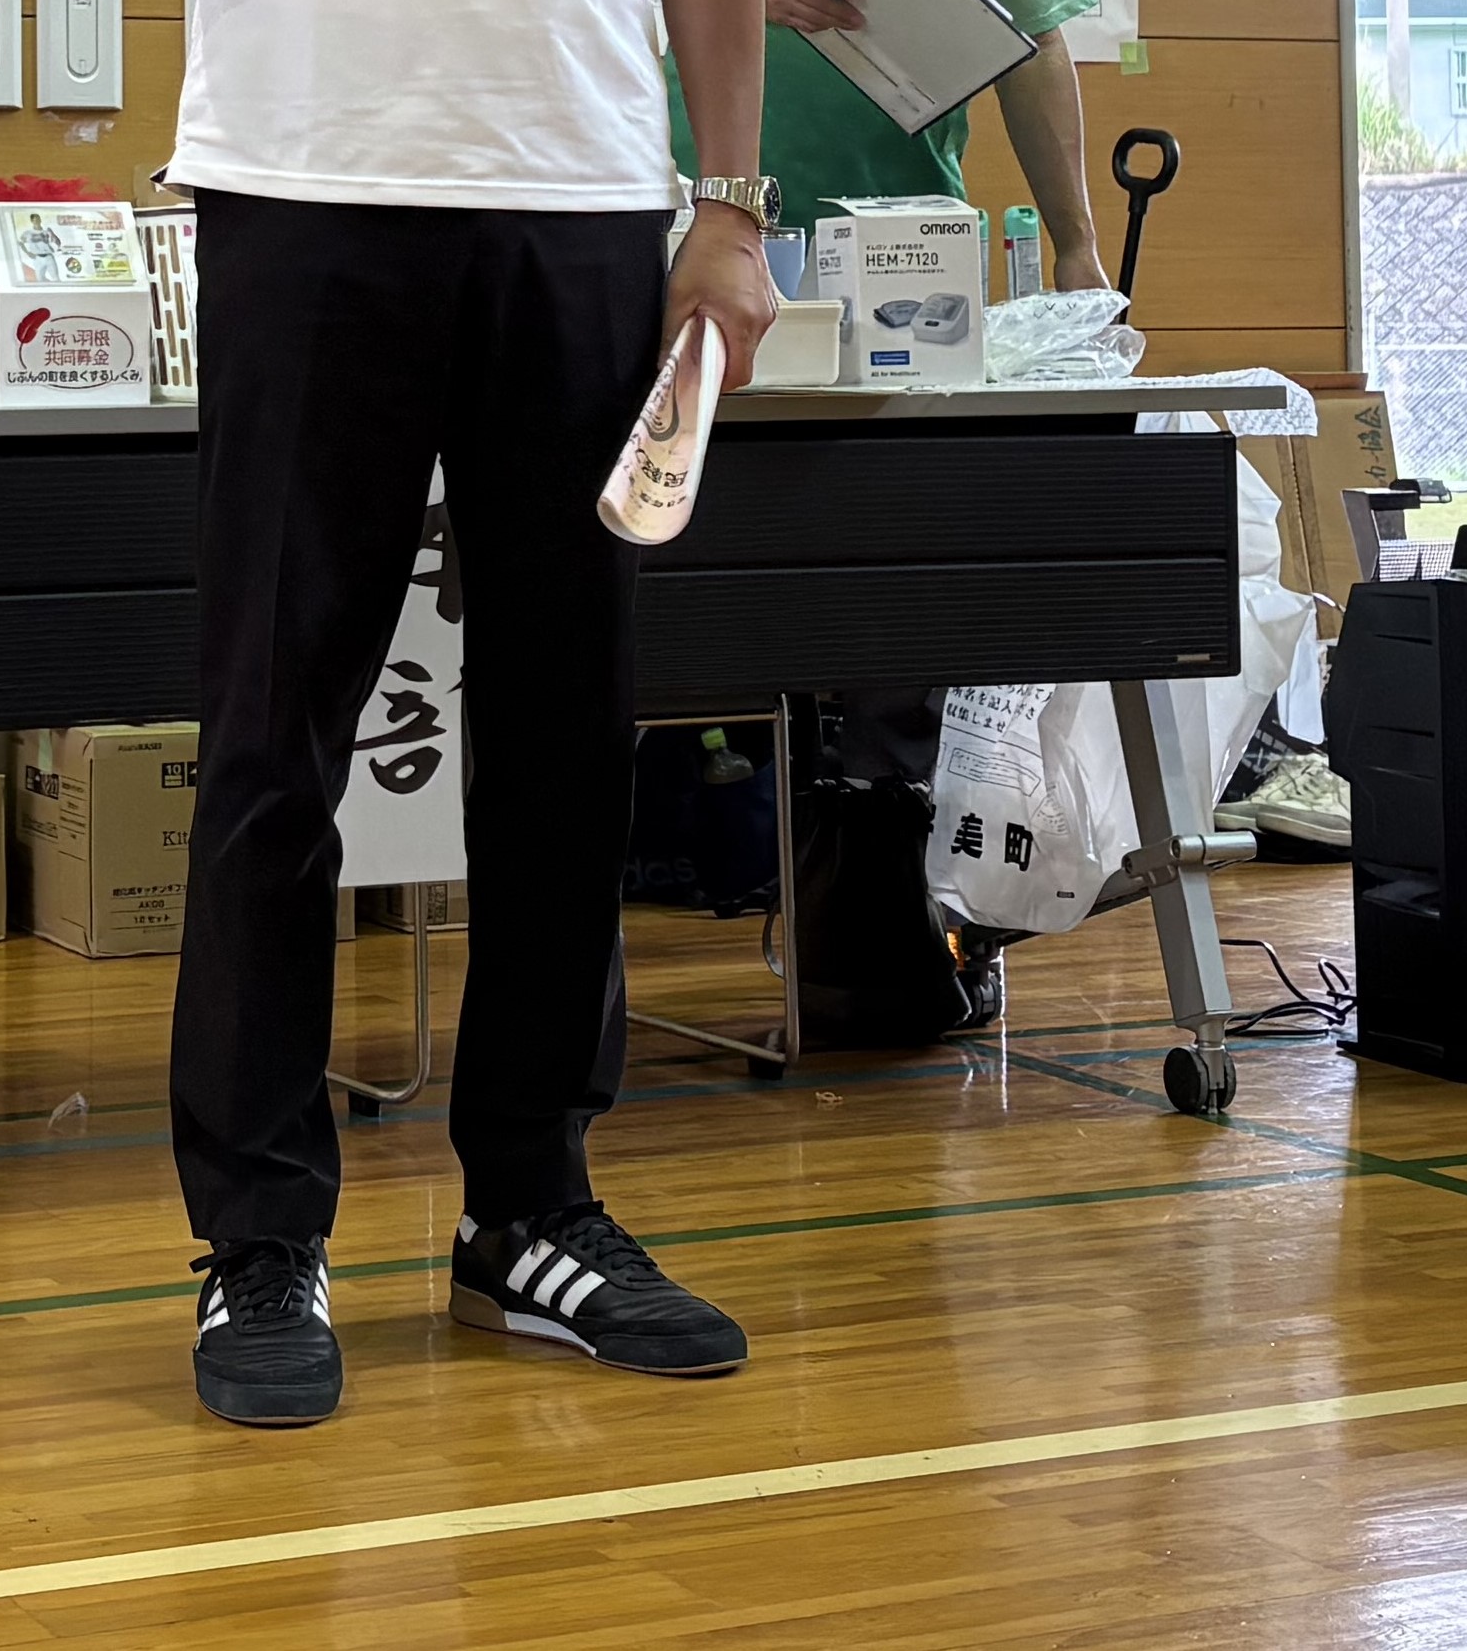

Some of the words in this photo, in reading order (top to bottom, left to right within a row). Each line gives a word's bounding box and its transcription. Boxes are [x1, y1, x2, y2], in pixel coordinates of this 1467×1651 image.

[865, 251, 940, 268] HEM-7120
[42, 328, 111, 348] 赤い羽根
[43, 348, 110, 367] 共同募金
[164, 763, 182, 775] 10
